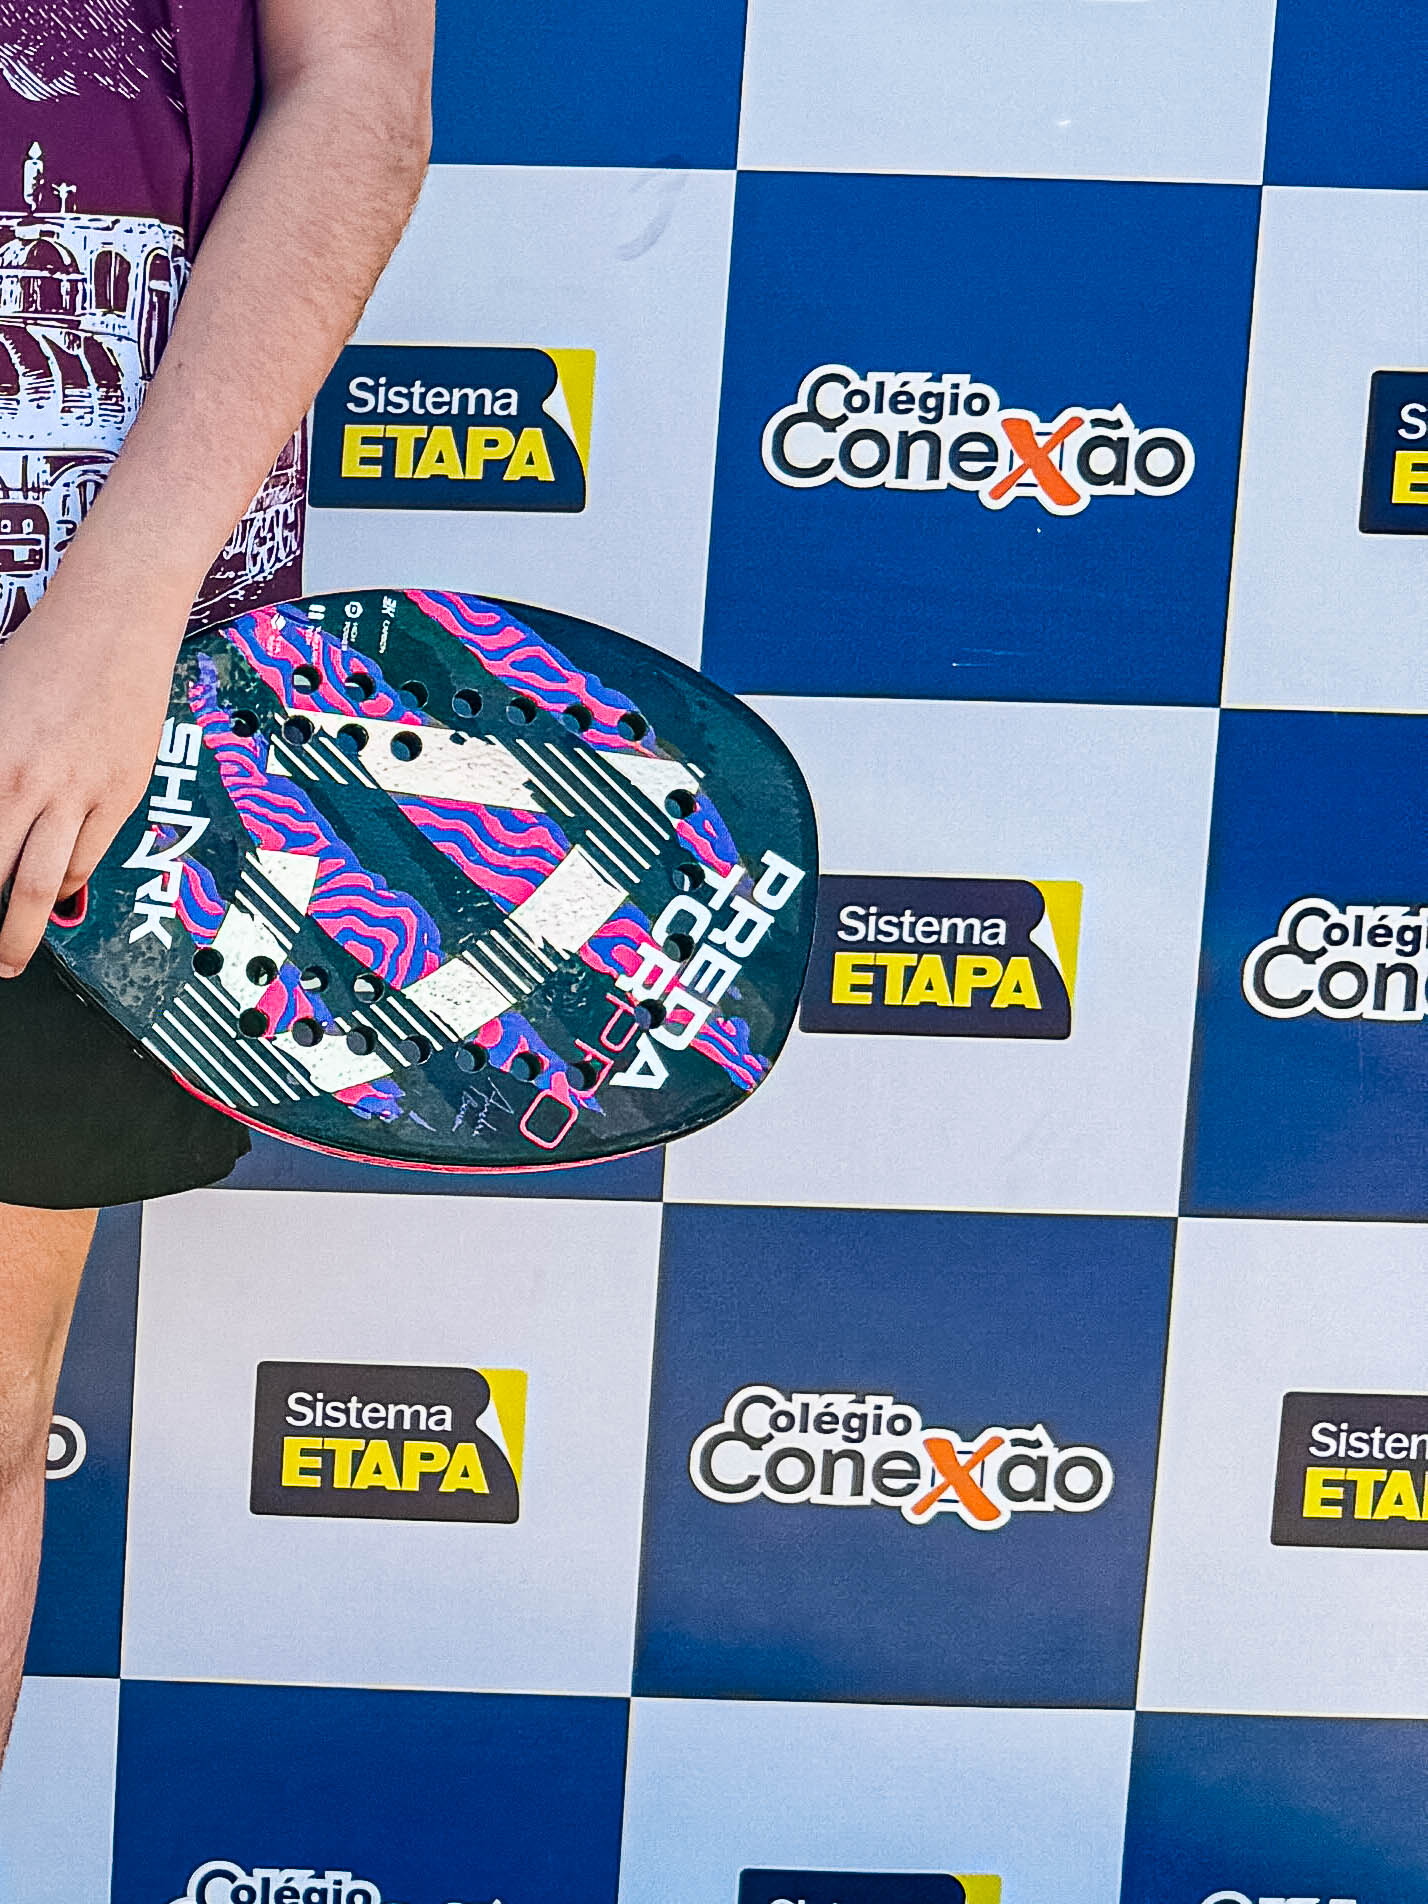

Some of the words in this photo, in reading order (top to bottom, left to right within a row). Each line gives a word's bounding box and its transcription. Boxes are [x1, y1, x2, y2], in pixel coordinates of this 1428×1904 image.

[345, 376, 519, 416] Sistema
[807, 372, 991, 425] Colégio
[340, 424, 555, 482] ETAPA
[121, 716, 211, 950] SHARK
[837, 905, 1007, 945] Sistema
[1288, 906, 1428, 958] Colég
[831, 951, 1042, 1009] ETAPA
[284, 1391, 453, 1431] Sistema
[734, 1394, 913, 1444] Colégio
[280, 1436, 489, 1494] ETAPA
[1302, 1467, 1428, 1524] ETA
